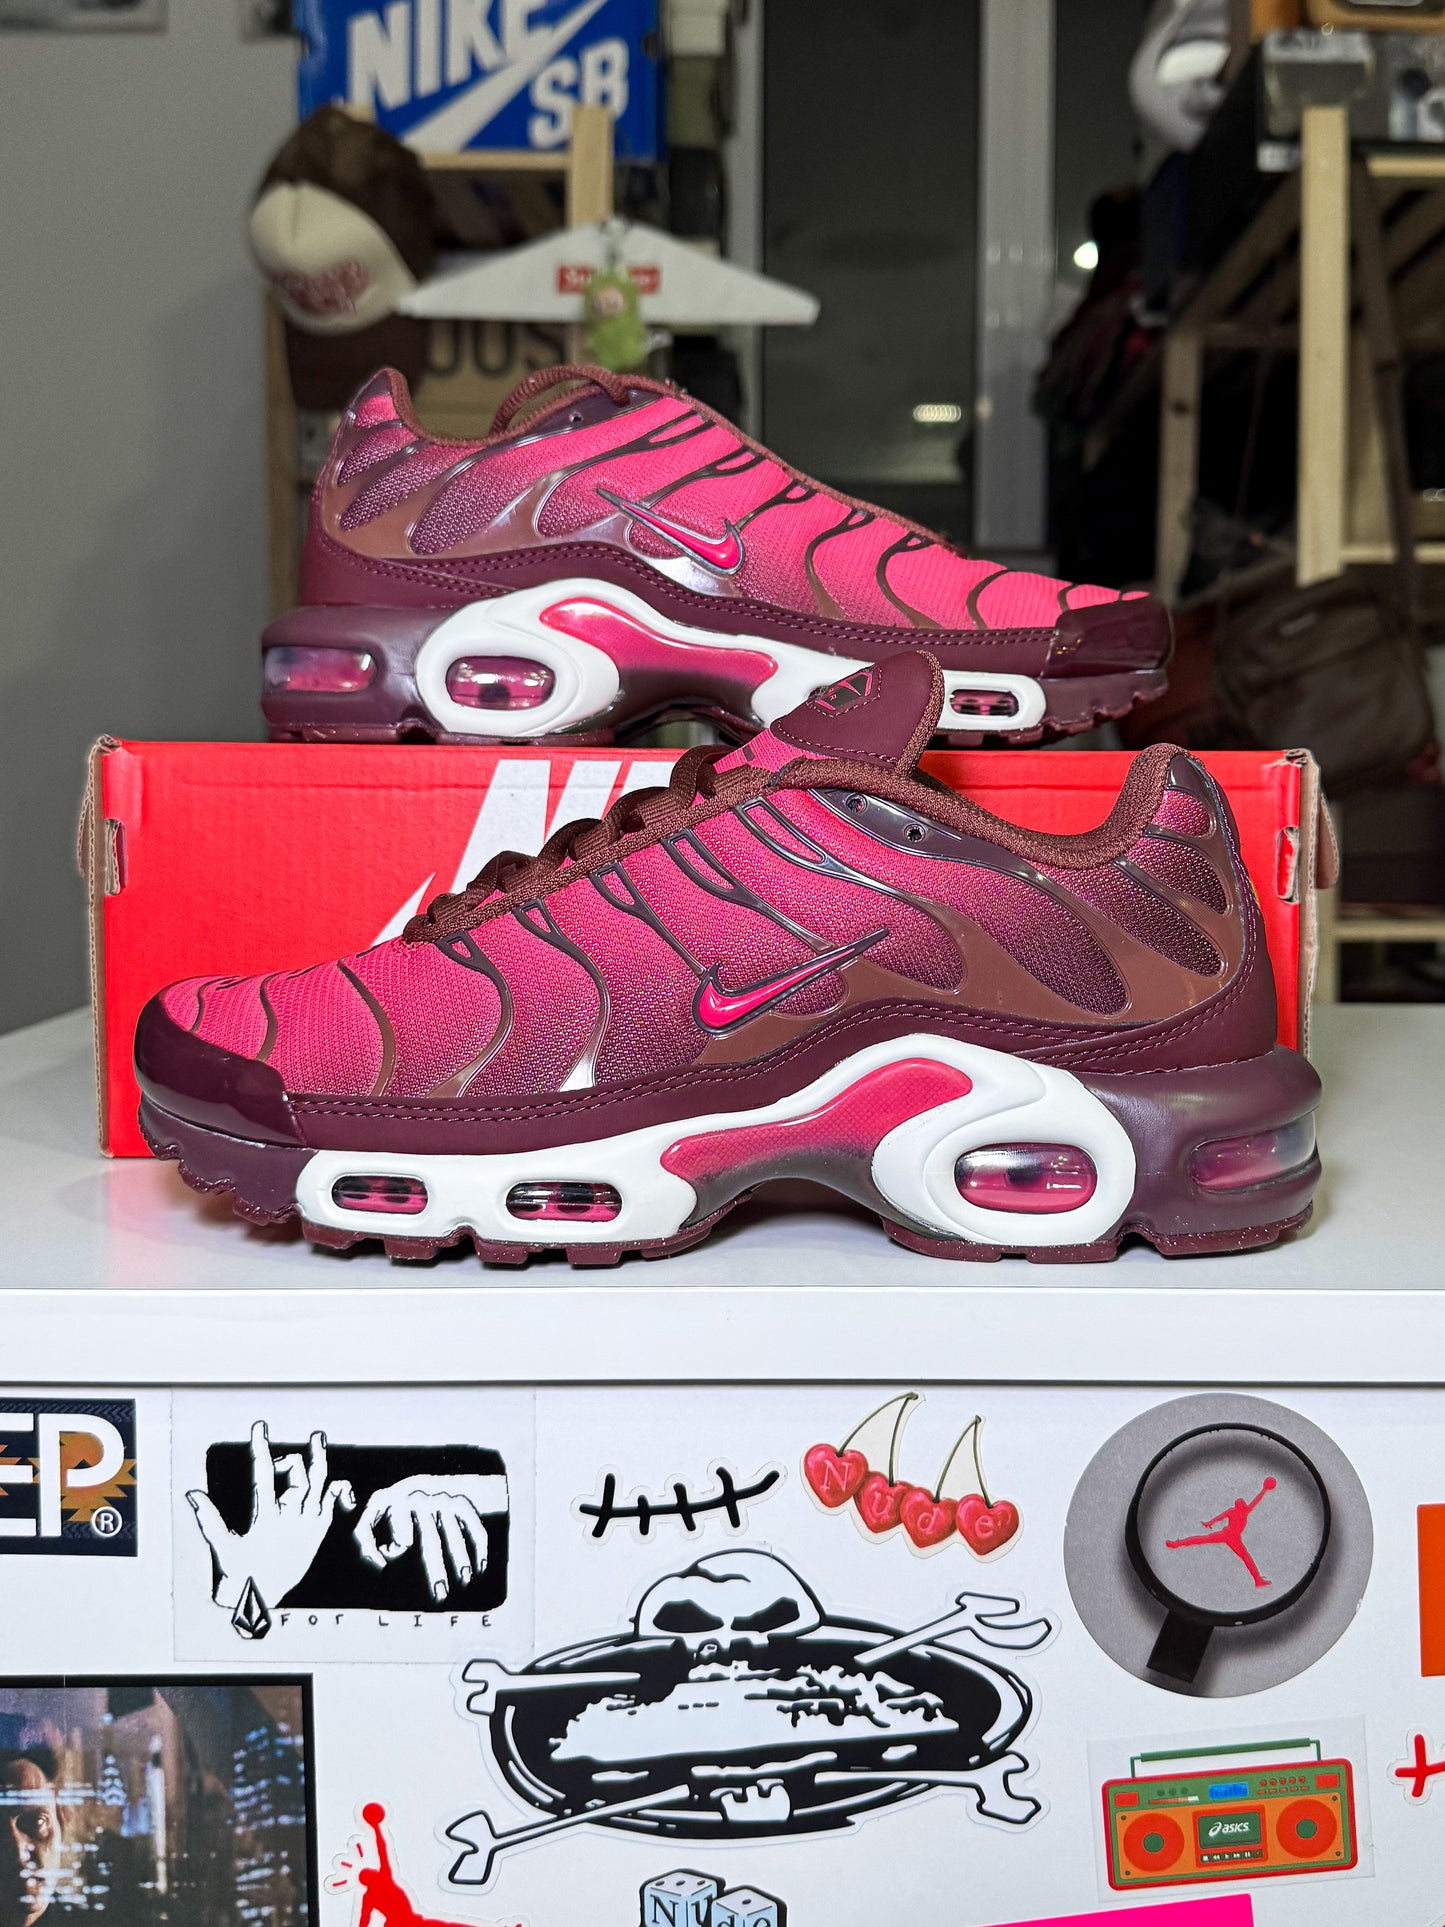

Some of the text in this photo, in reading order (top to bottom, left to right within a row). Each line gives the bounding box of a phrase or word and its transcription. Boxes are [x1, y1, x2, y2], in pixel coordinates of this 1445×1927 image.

[531, 38, 629, 147] SB
[820, 1459, 994, 1539] Nude
[378, 1614, 492, 1627] LIFE
